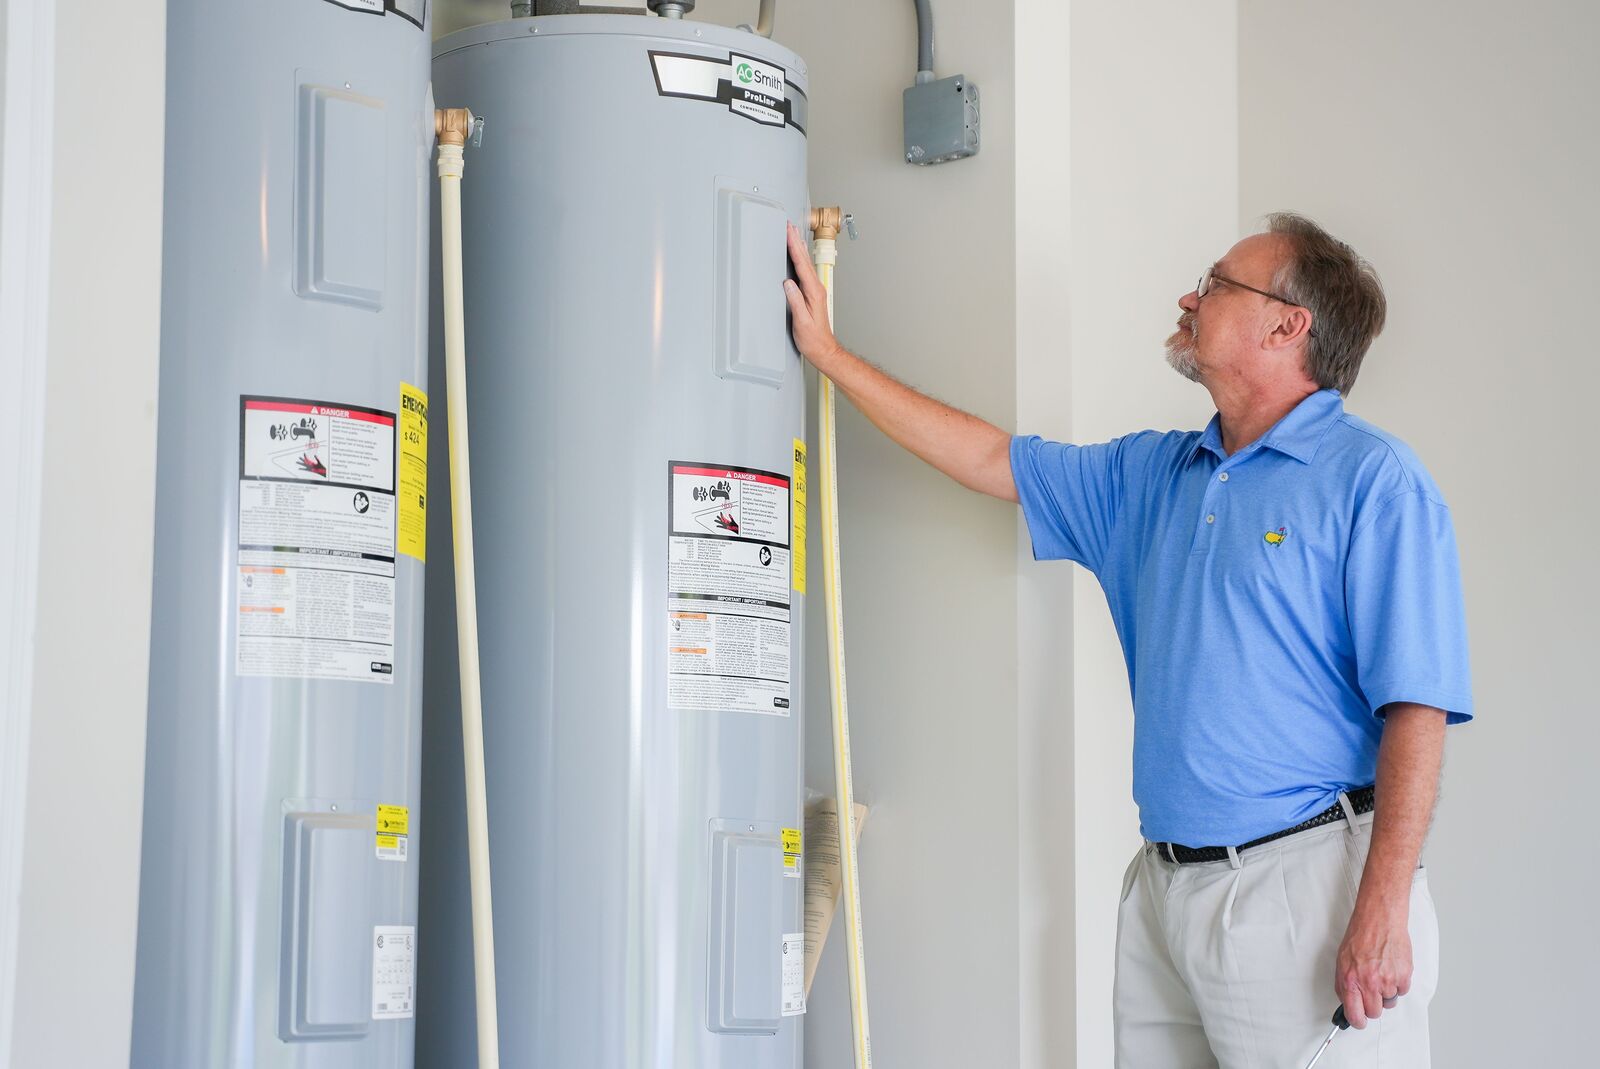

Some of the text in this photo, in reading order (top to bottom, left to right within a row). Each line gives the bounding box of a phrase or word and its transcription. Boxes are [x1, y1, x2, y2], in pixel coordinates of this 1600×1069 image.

[754, 70, 782, 91] Smith
[744, 91, 776, 106] ProLine
[320, 407, 350, 418] DANGER
[733, 473, 757, 481] DANGER
